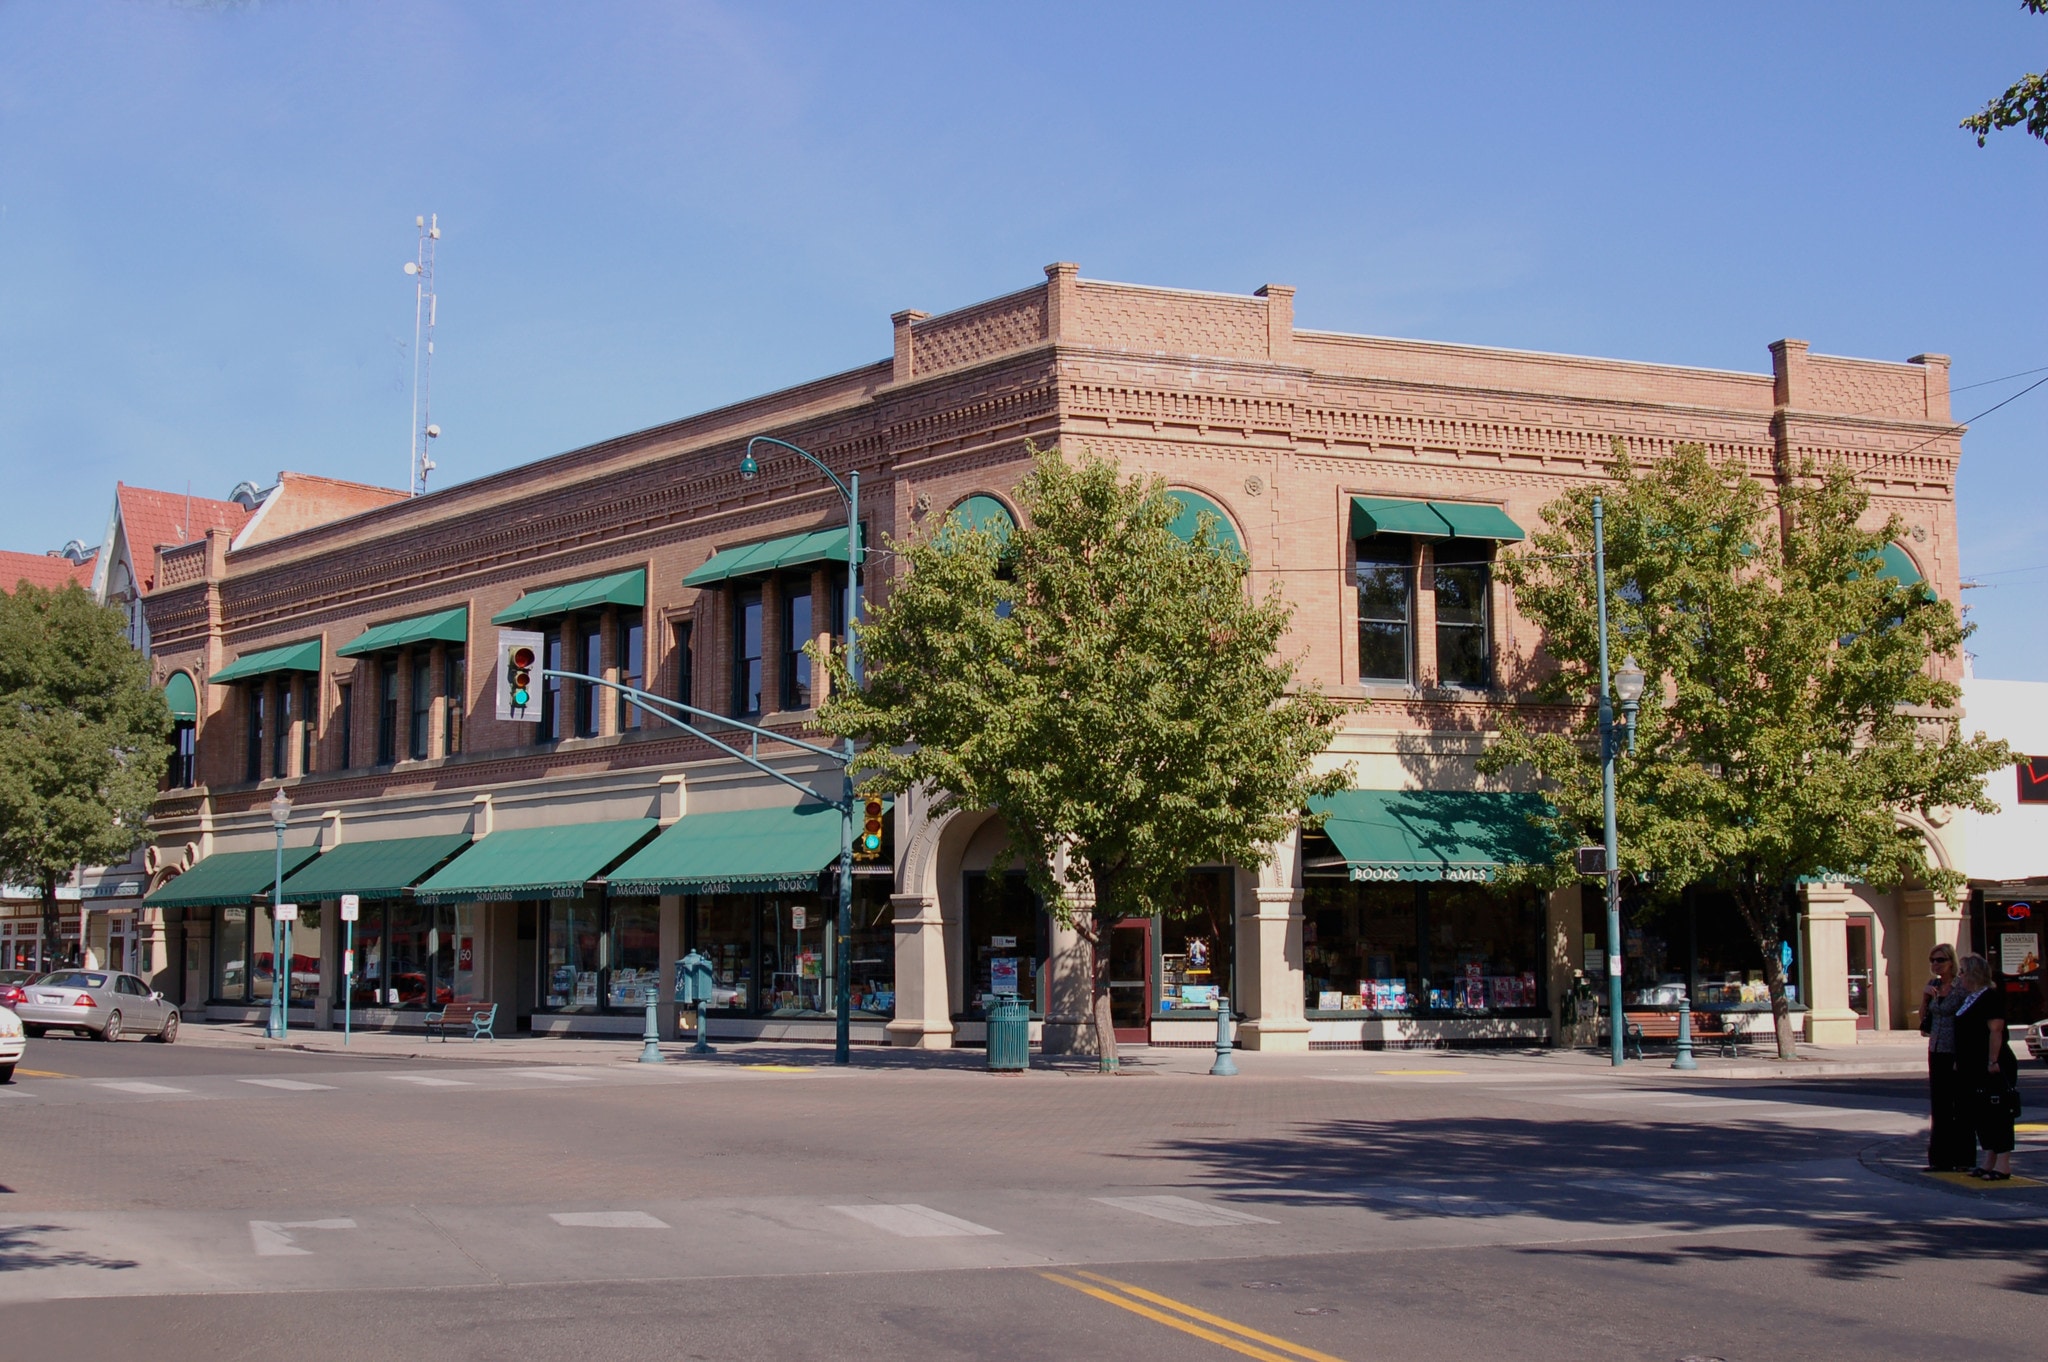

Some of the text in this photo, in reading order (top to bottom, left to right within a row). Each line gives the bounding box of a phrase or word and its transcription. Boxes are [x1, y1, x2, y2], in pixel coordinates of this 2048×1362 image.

[1354, 868, 1486, 880] BOOKS GAMES
[616, 880, 807, 895] MAGAZINES GAMES BOOKS
[422, 888, 575, 904] GIFTS SOUVENIRS CARDS
[2007, 905, 2031, 917] OPEN
